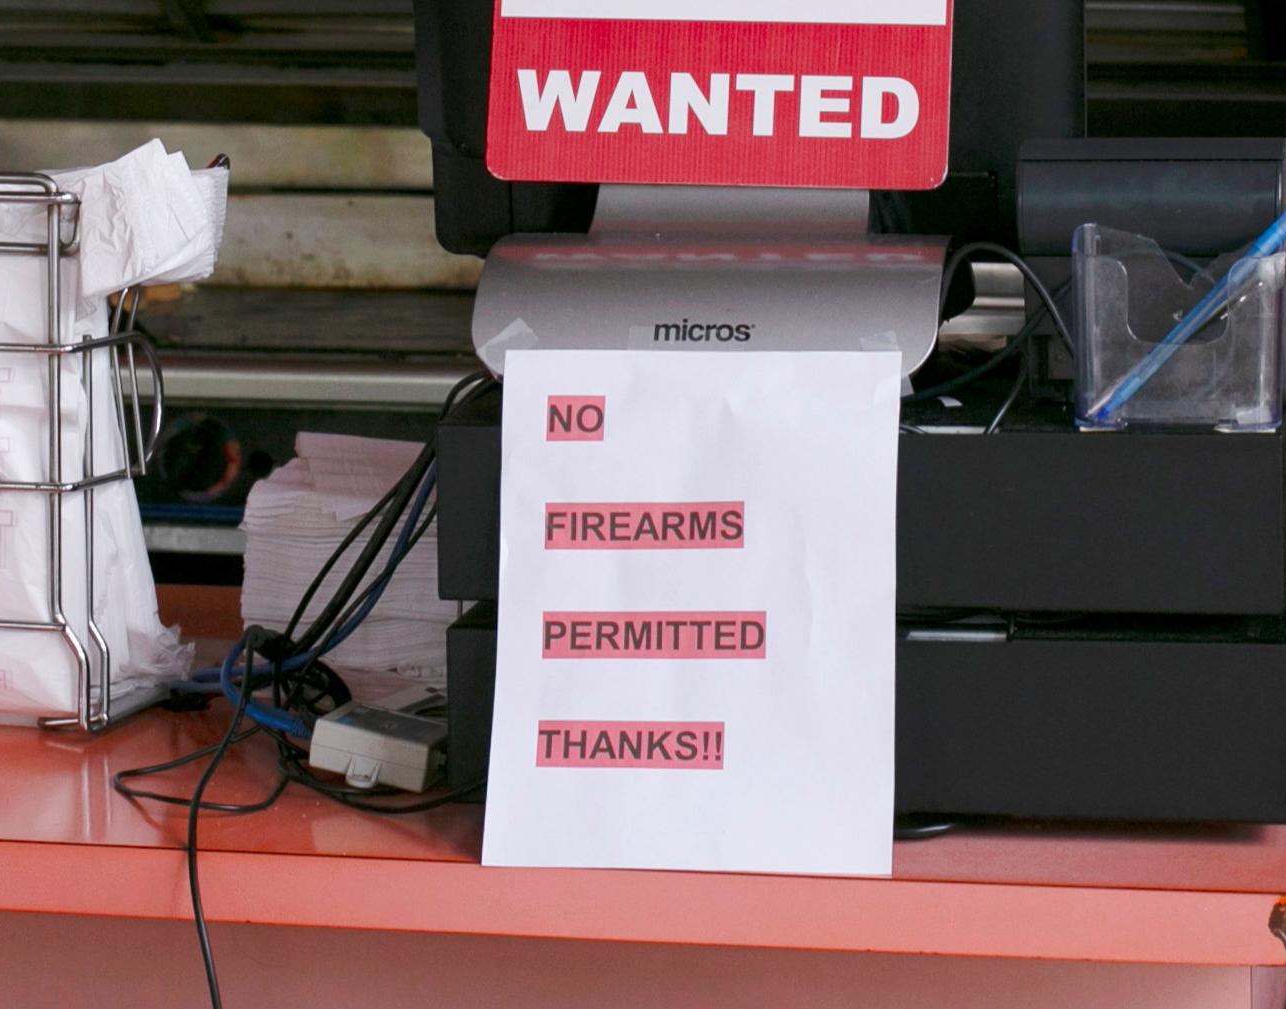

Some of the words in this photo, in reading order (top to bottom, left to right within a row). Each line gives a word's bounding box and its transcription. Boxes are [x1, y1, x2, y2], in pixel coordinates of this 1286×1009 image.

[517, 69, 919, 139] WANTED
[654, 319, 752, 343] micros
[548, 403, 605, 434] NO
[546, 510, 744, 543] FIREARMS
[544, 621, 767, 651] PERMITTED
[539, 729, 723, 762] THANKS!!
